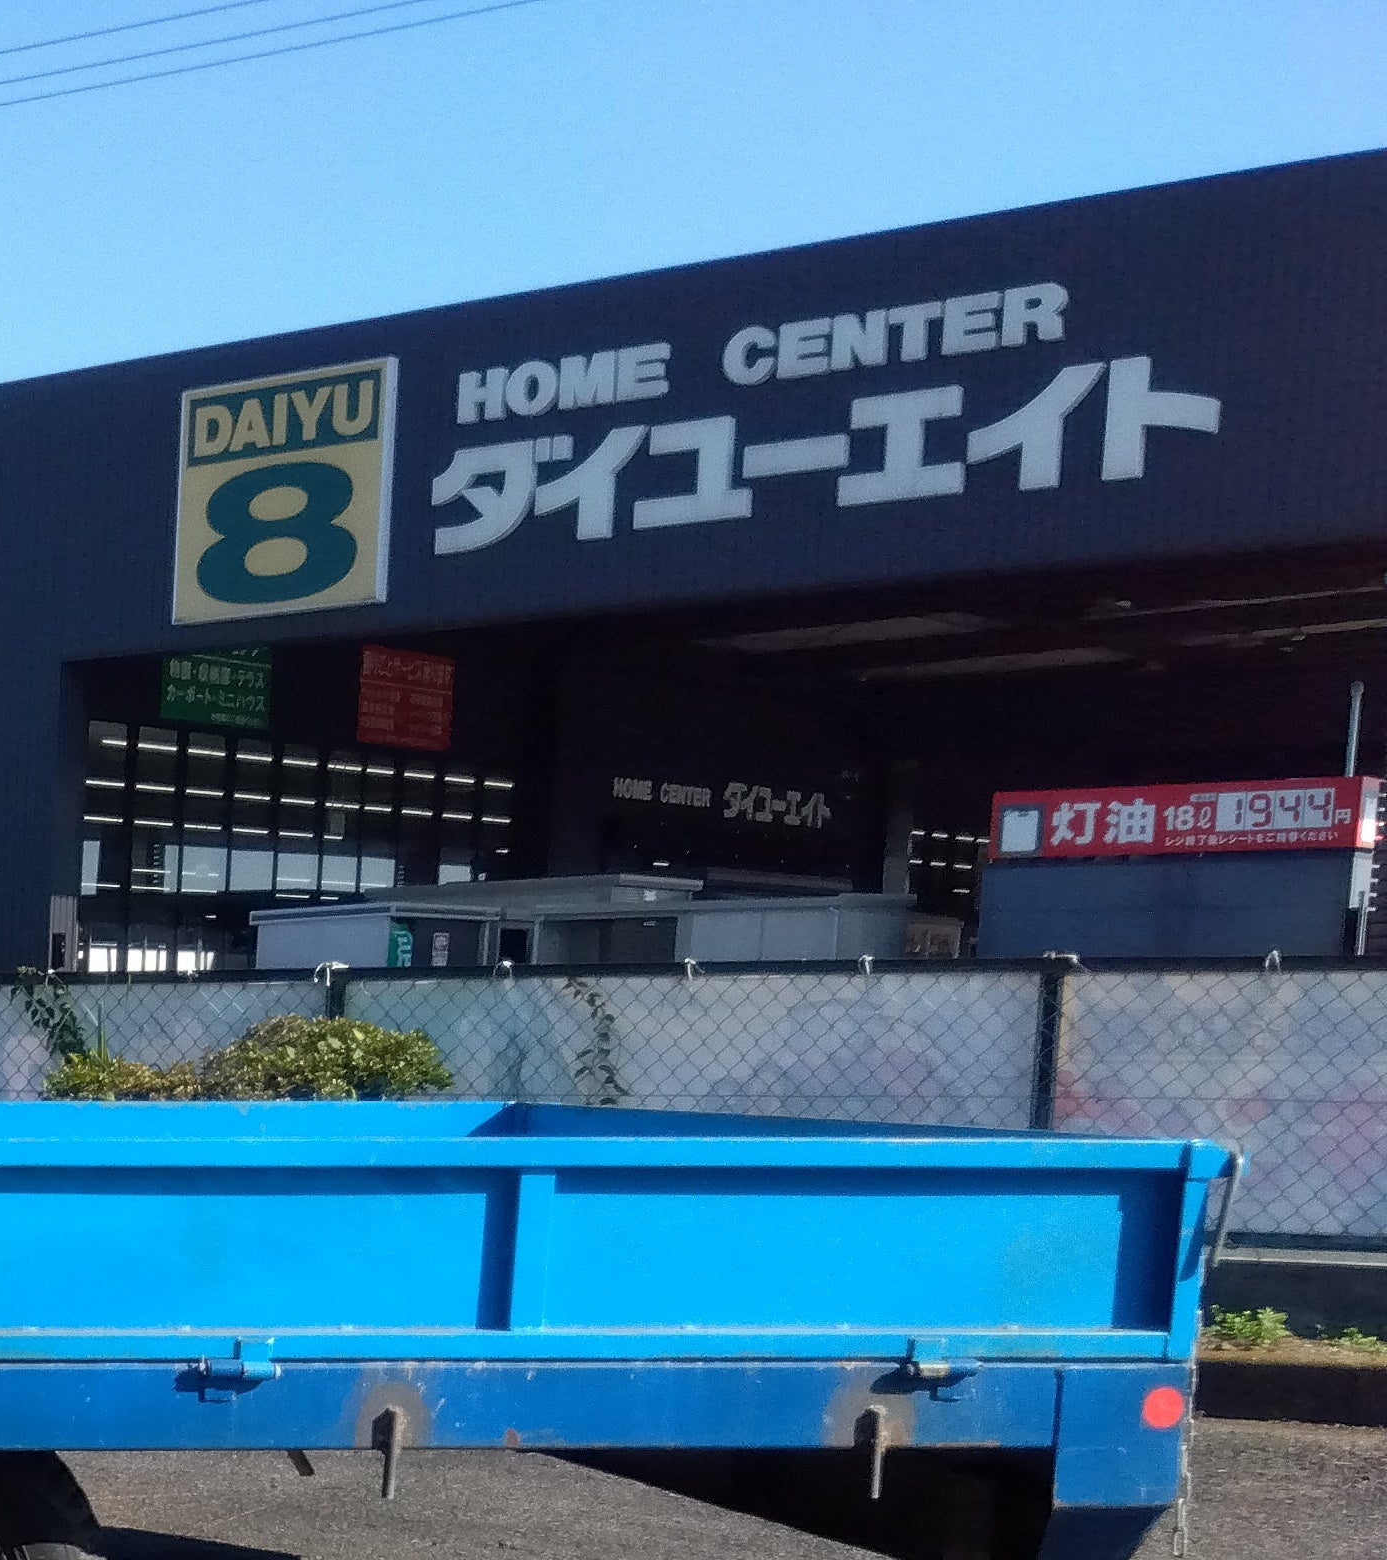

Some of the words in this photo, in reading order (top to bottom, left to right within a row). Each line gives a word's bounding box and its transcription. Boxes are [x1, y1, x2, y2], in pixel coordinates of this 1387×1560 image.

[456, 343, 671, 425] HOME
[722, 282, 1070, 386] CENTER
[192, 372, 375, 458] DAIYU
[432, 356, 1221, 554] ダイユーエイト
[195, 461, 359, 605] 8
[613, 776, 654, 801] HOME
[659, 781, 713, 808] CENTER
[723, 781, 832, 829] ダイユーエイト
[1050, 797, 1157, 846] 灯油
[1233, 792, 1332, 828] 1944
